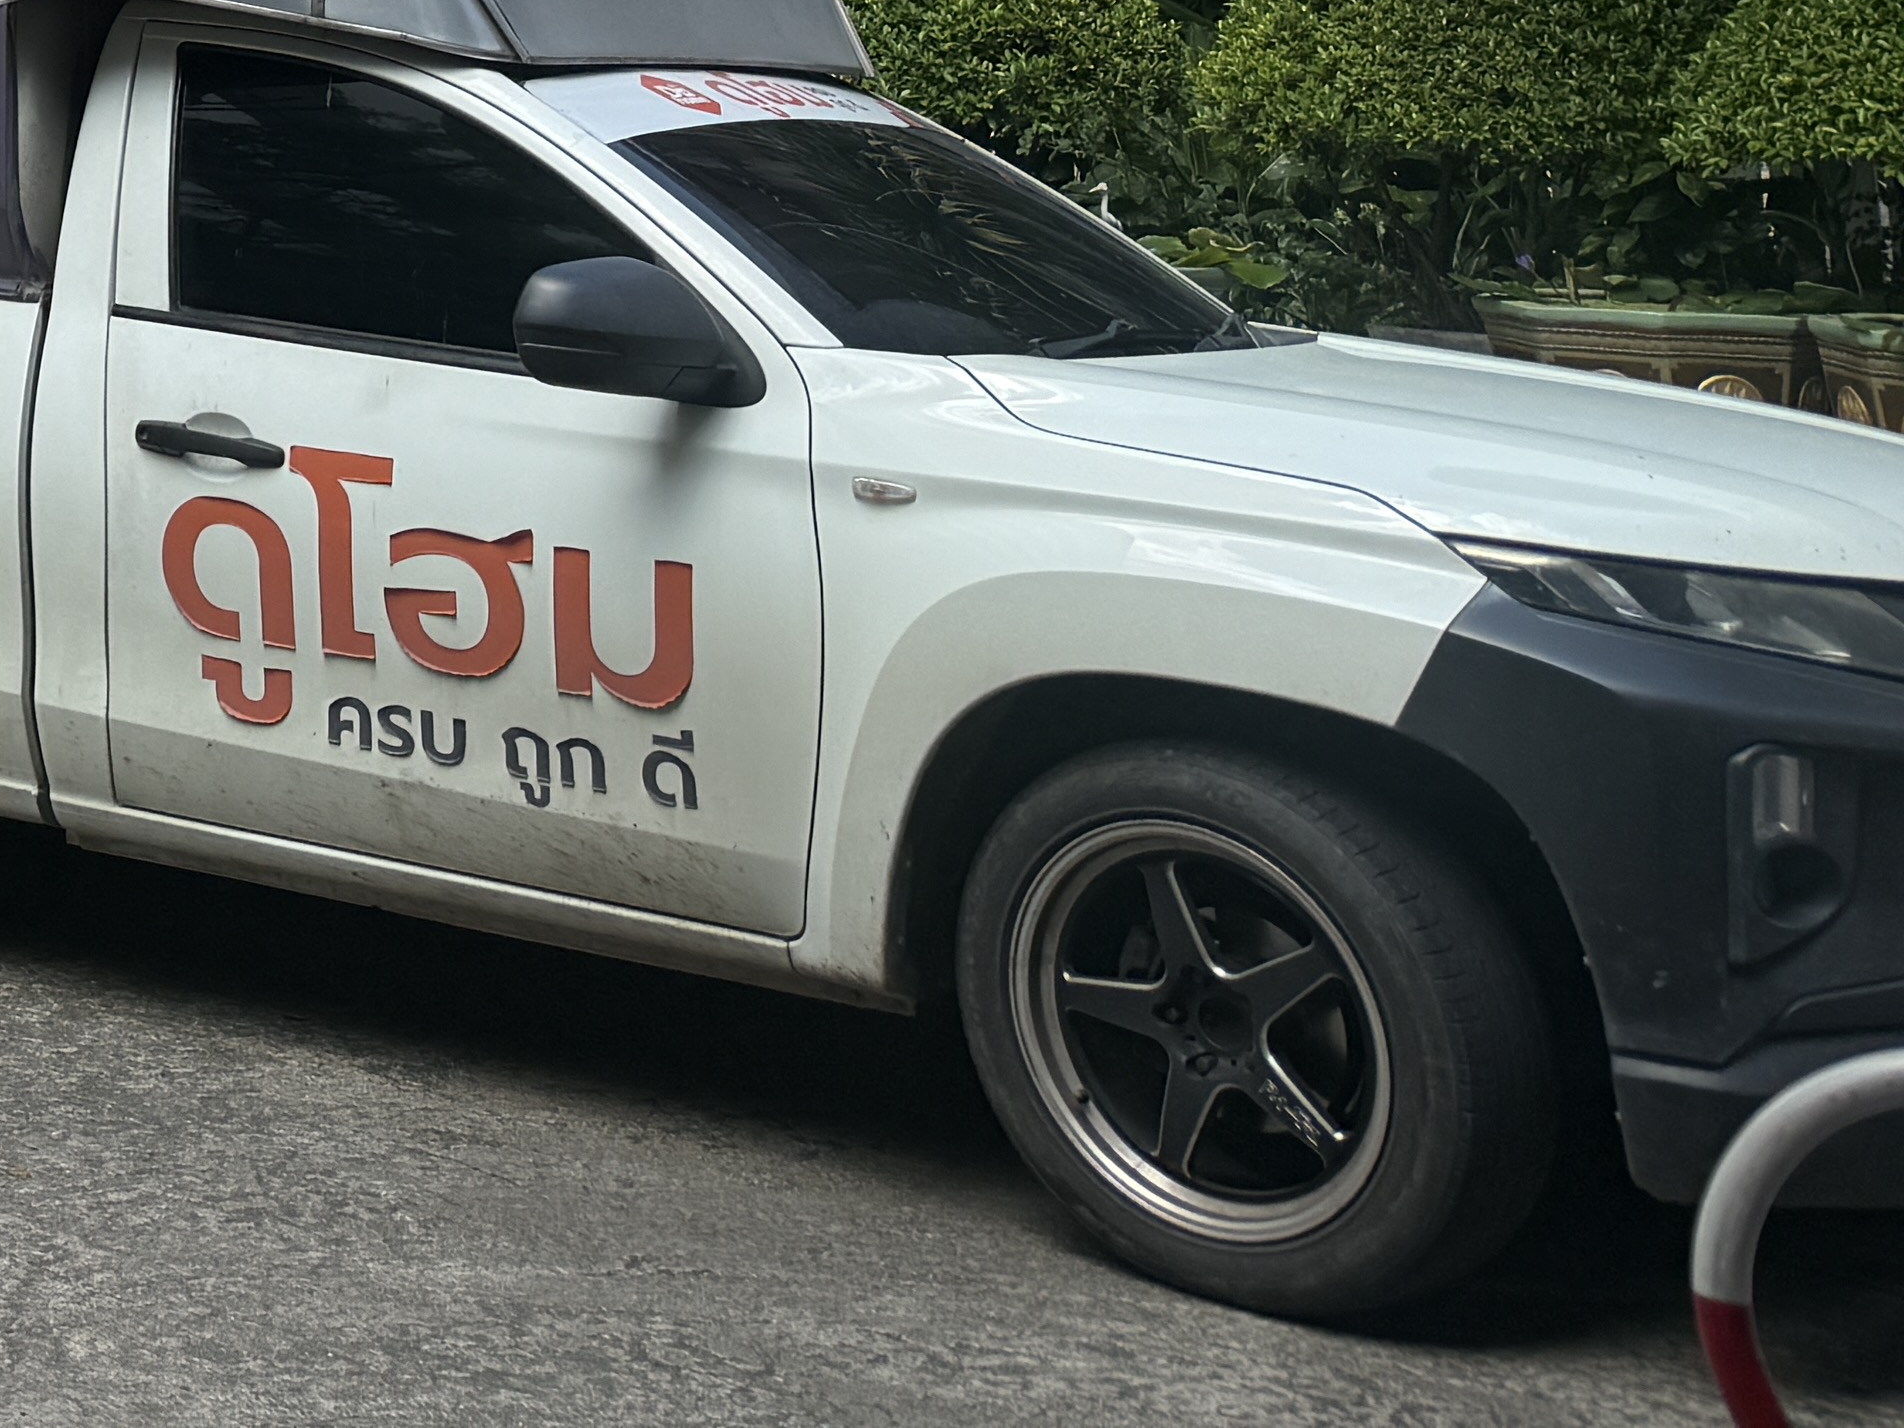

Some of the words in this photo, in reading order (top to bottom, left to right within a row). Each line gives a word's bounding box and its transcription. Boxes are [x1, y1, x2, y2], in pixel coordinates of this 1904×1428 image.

[161, 445, 695, 725] ดูโฮม
[327, 695, 467, 766] ครบ
[503, 724, 608, 806] ถูก
[640, 728, 699, 810] ดี
